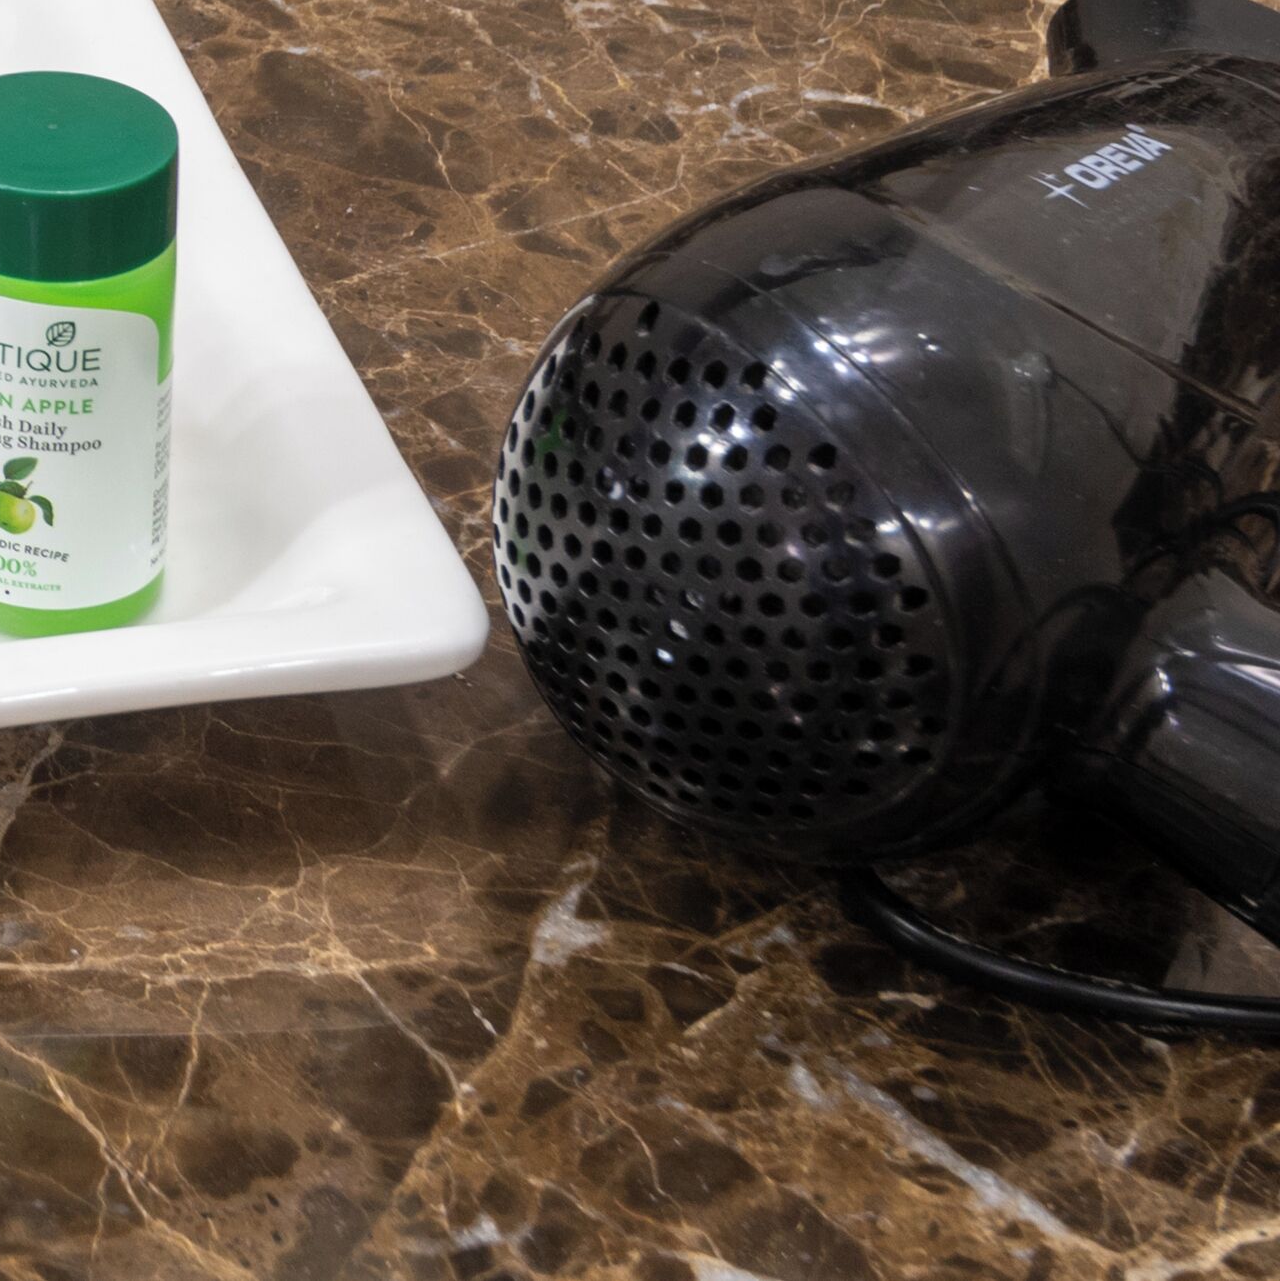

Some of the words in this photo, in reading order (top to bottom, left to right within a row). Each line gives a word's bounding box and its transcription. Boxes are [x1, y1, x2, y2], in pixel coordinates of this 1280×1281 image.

[1064, 132, 1173, 190] OREVA
[19, 375, 99, 388] AYURVEDA
[22, 397, 94, 415] APPLE
[19, 418, 67, 439] Daily
[17, 432, 102, 456] Shampoo
[24, 544, 70, 562] RECIPE
